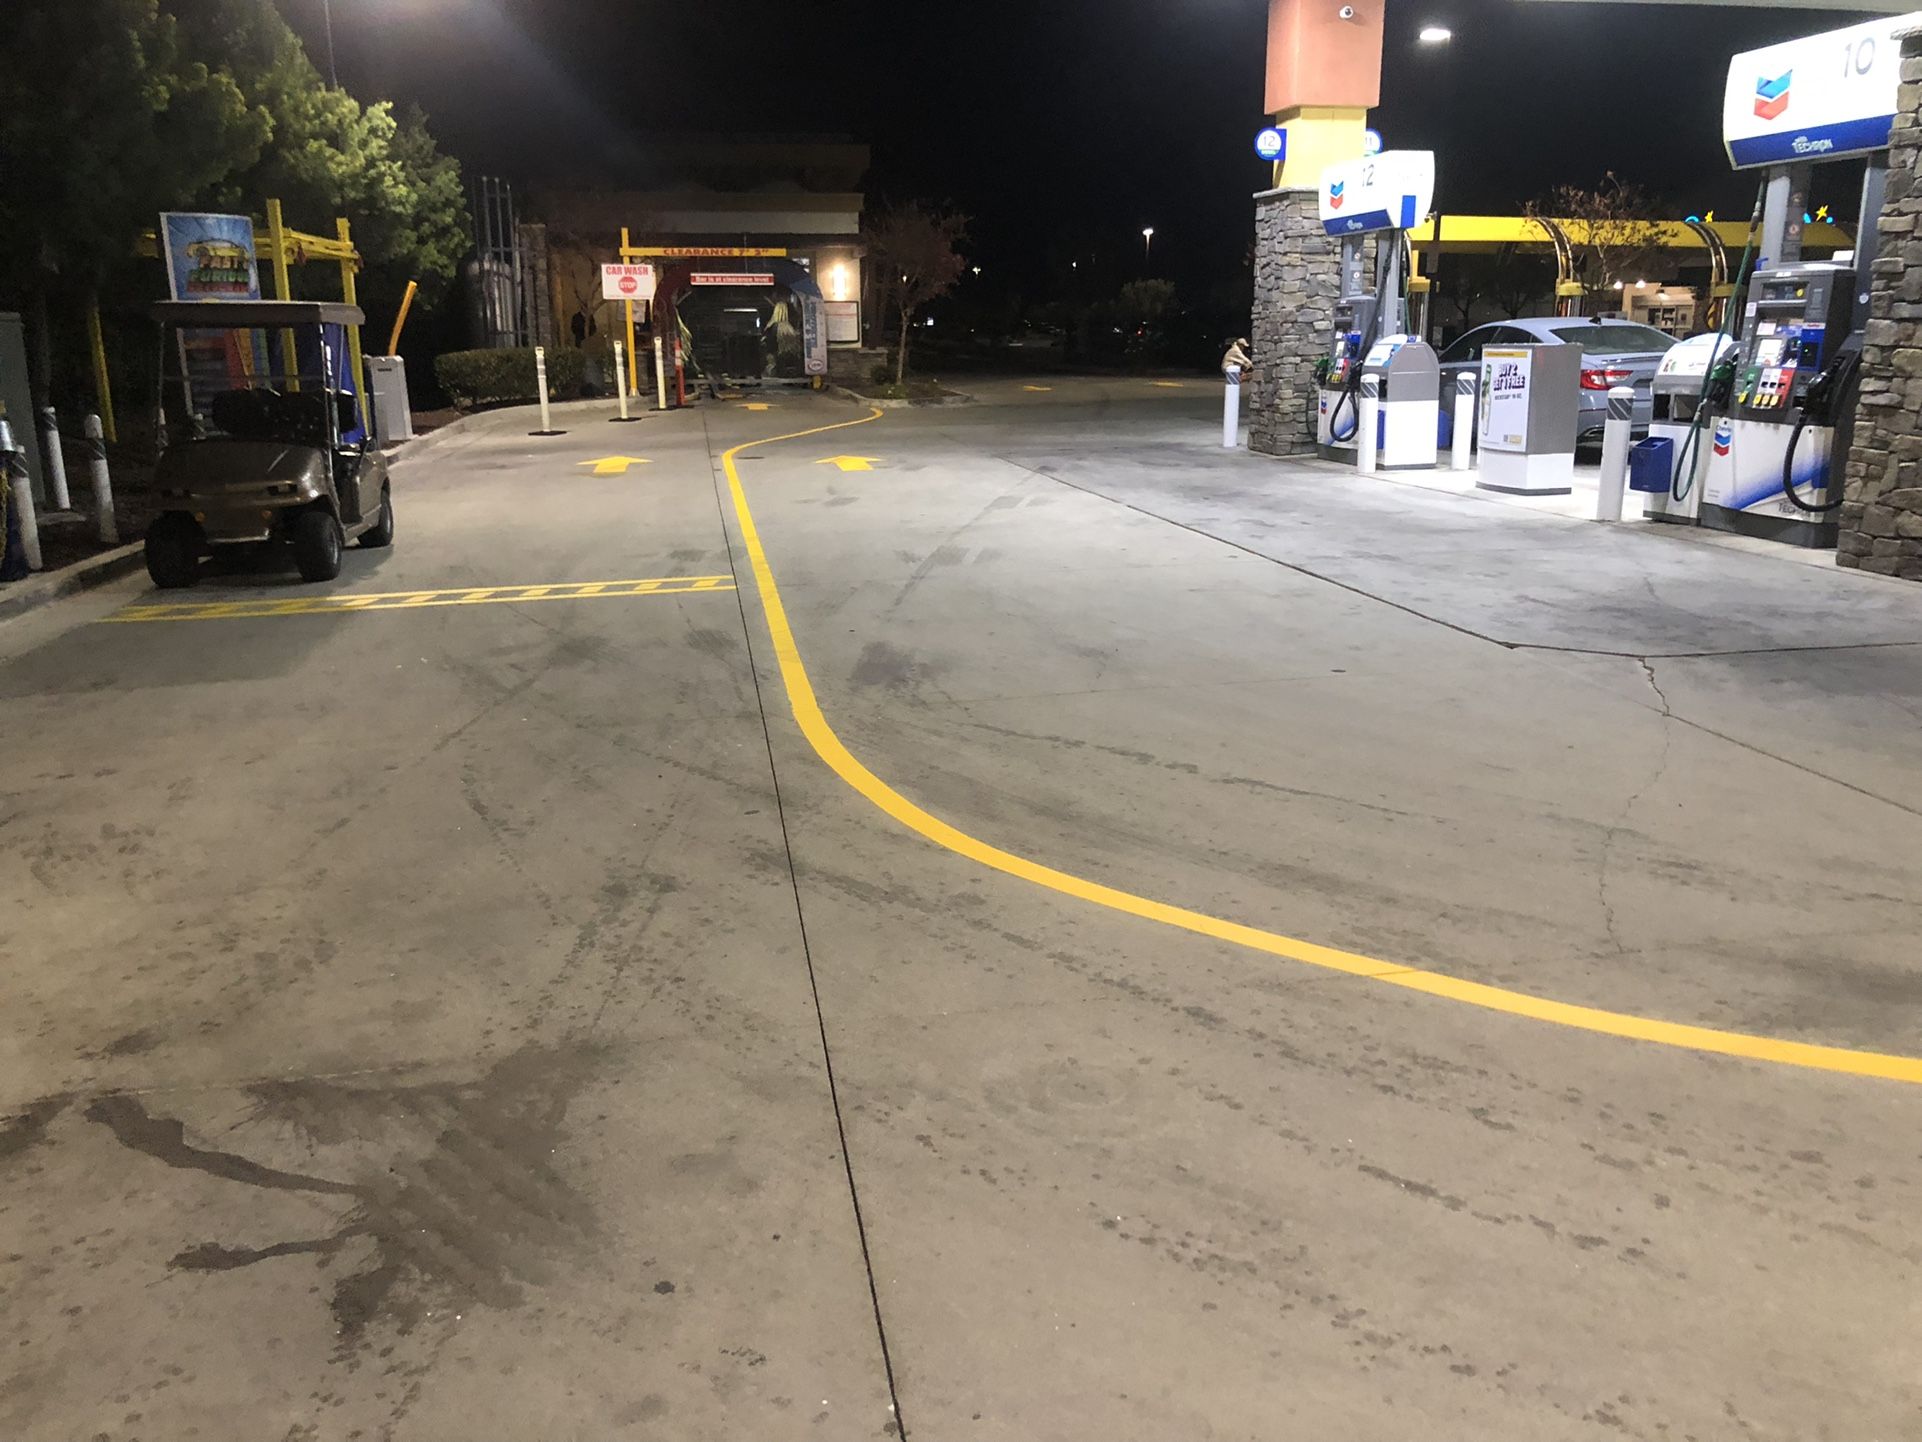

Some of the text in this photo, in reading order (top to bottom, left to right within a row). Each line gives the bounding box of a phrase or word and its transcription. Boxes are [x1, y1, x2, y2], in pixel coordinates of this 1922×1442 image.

[1844, 36, 1876, 78] 10
[1262, 135, 1276, 147] 12
[1361, 163, 1375, 187] 12
[663, 248, 734, 256] CLEARANCE
[605, 265, 649, 276] CAR WASH
[619, 281, 637, 289] STOP
